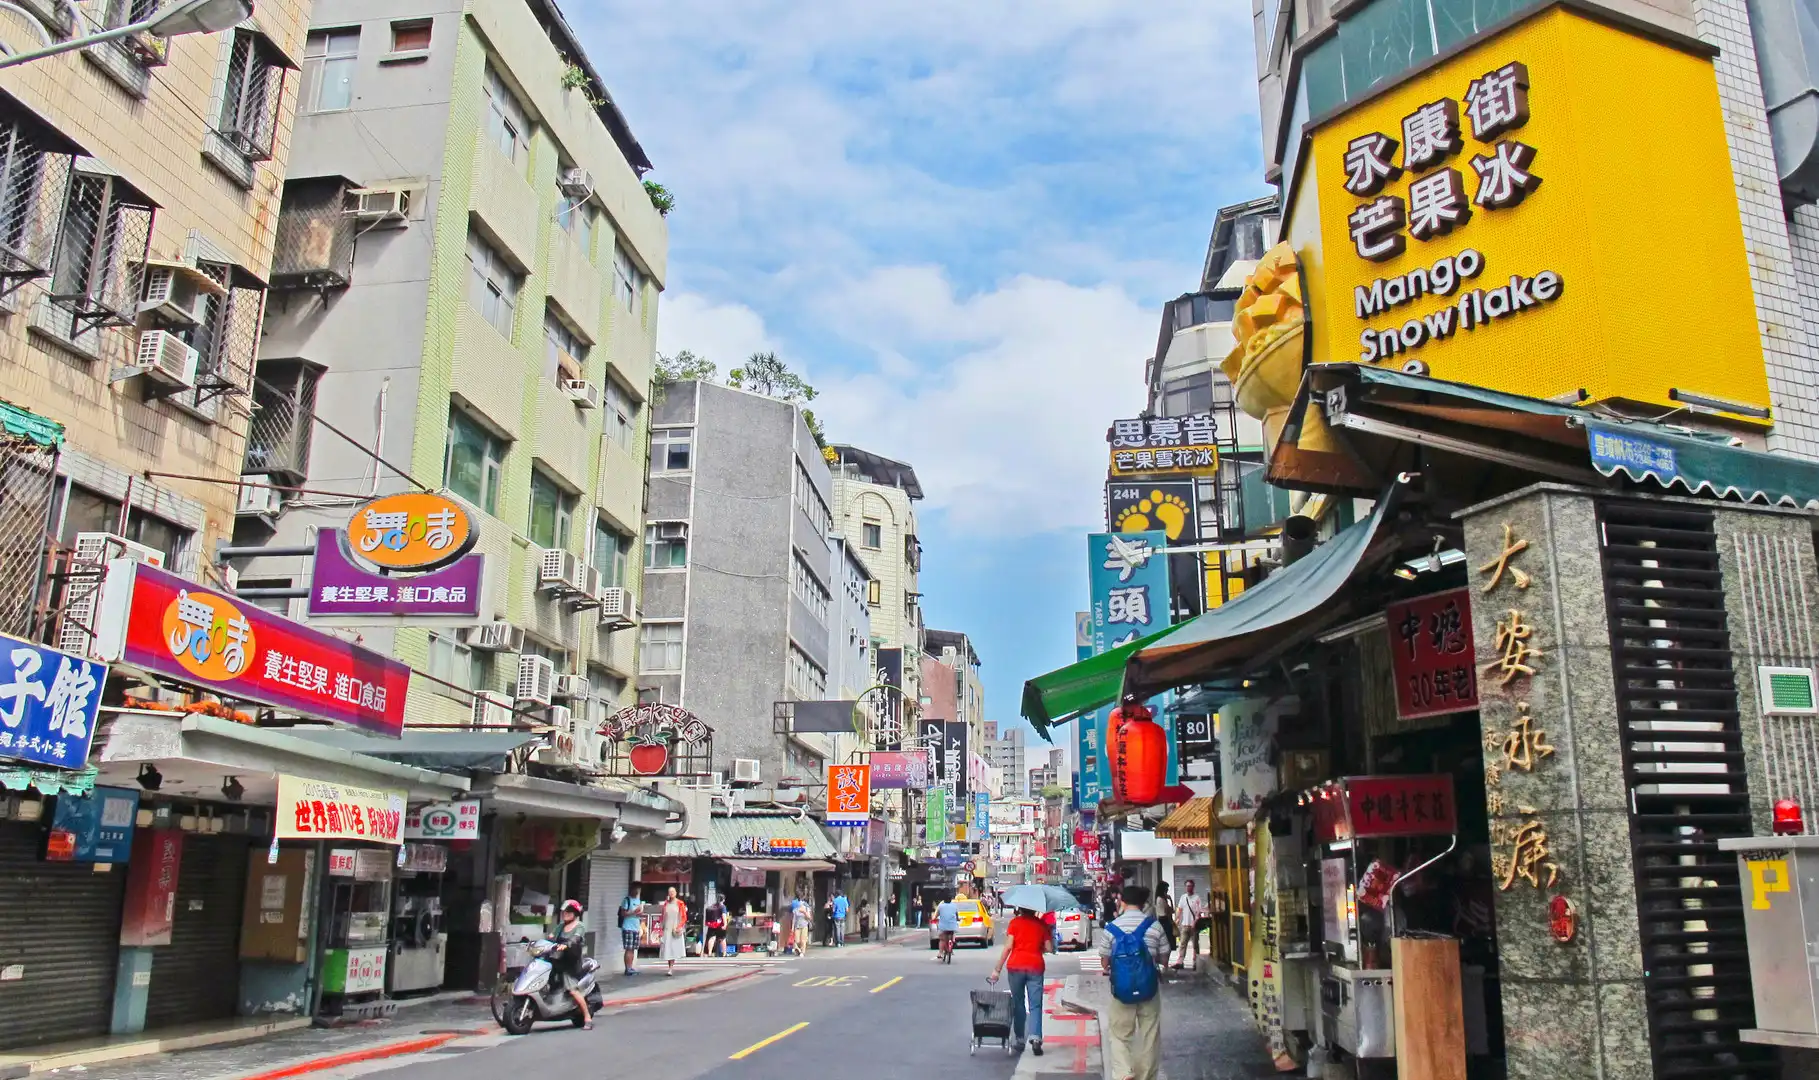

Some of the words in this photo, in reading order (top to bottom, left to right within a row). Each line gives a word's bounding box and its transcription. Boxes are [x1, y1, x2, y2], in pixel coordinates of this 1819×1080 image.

[1344, 62, 1524, 194] 永康街
[1349, 143, 1534, 262] 芒果冰
[1354, 249, 1483, 318] Mango
[1360, 270, 1561, 362] Snowflake
[1113, 415, 1217, 447] 思慕昔
[1116, 448, 1213, 470] 芒果雪花冰
[1113, 489, 1140, 500] 24H
[1094, 600, 1105, 627] TARO
[1478, 523, 1557, 889] 大安永康
[1186, 721, 1205, 735] 80
[835, 767, 861, 811] 誠記
[295, 799, 365, 835] 世界前10名
